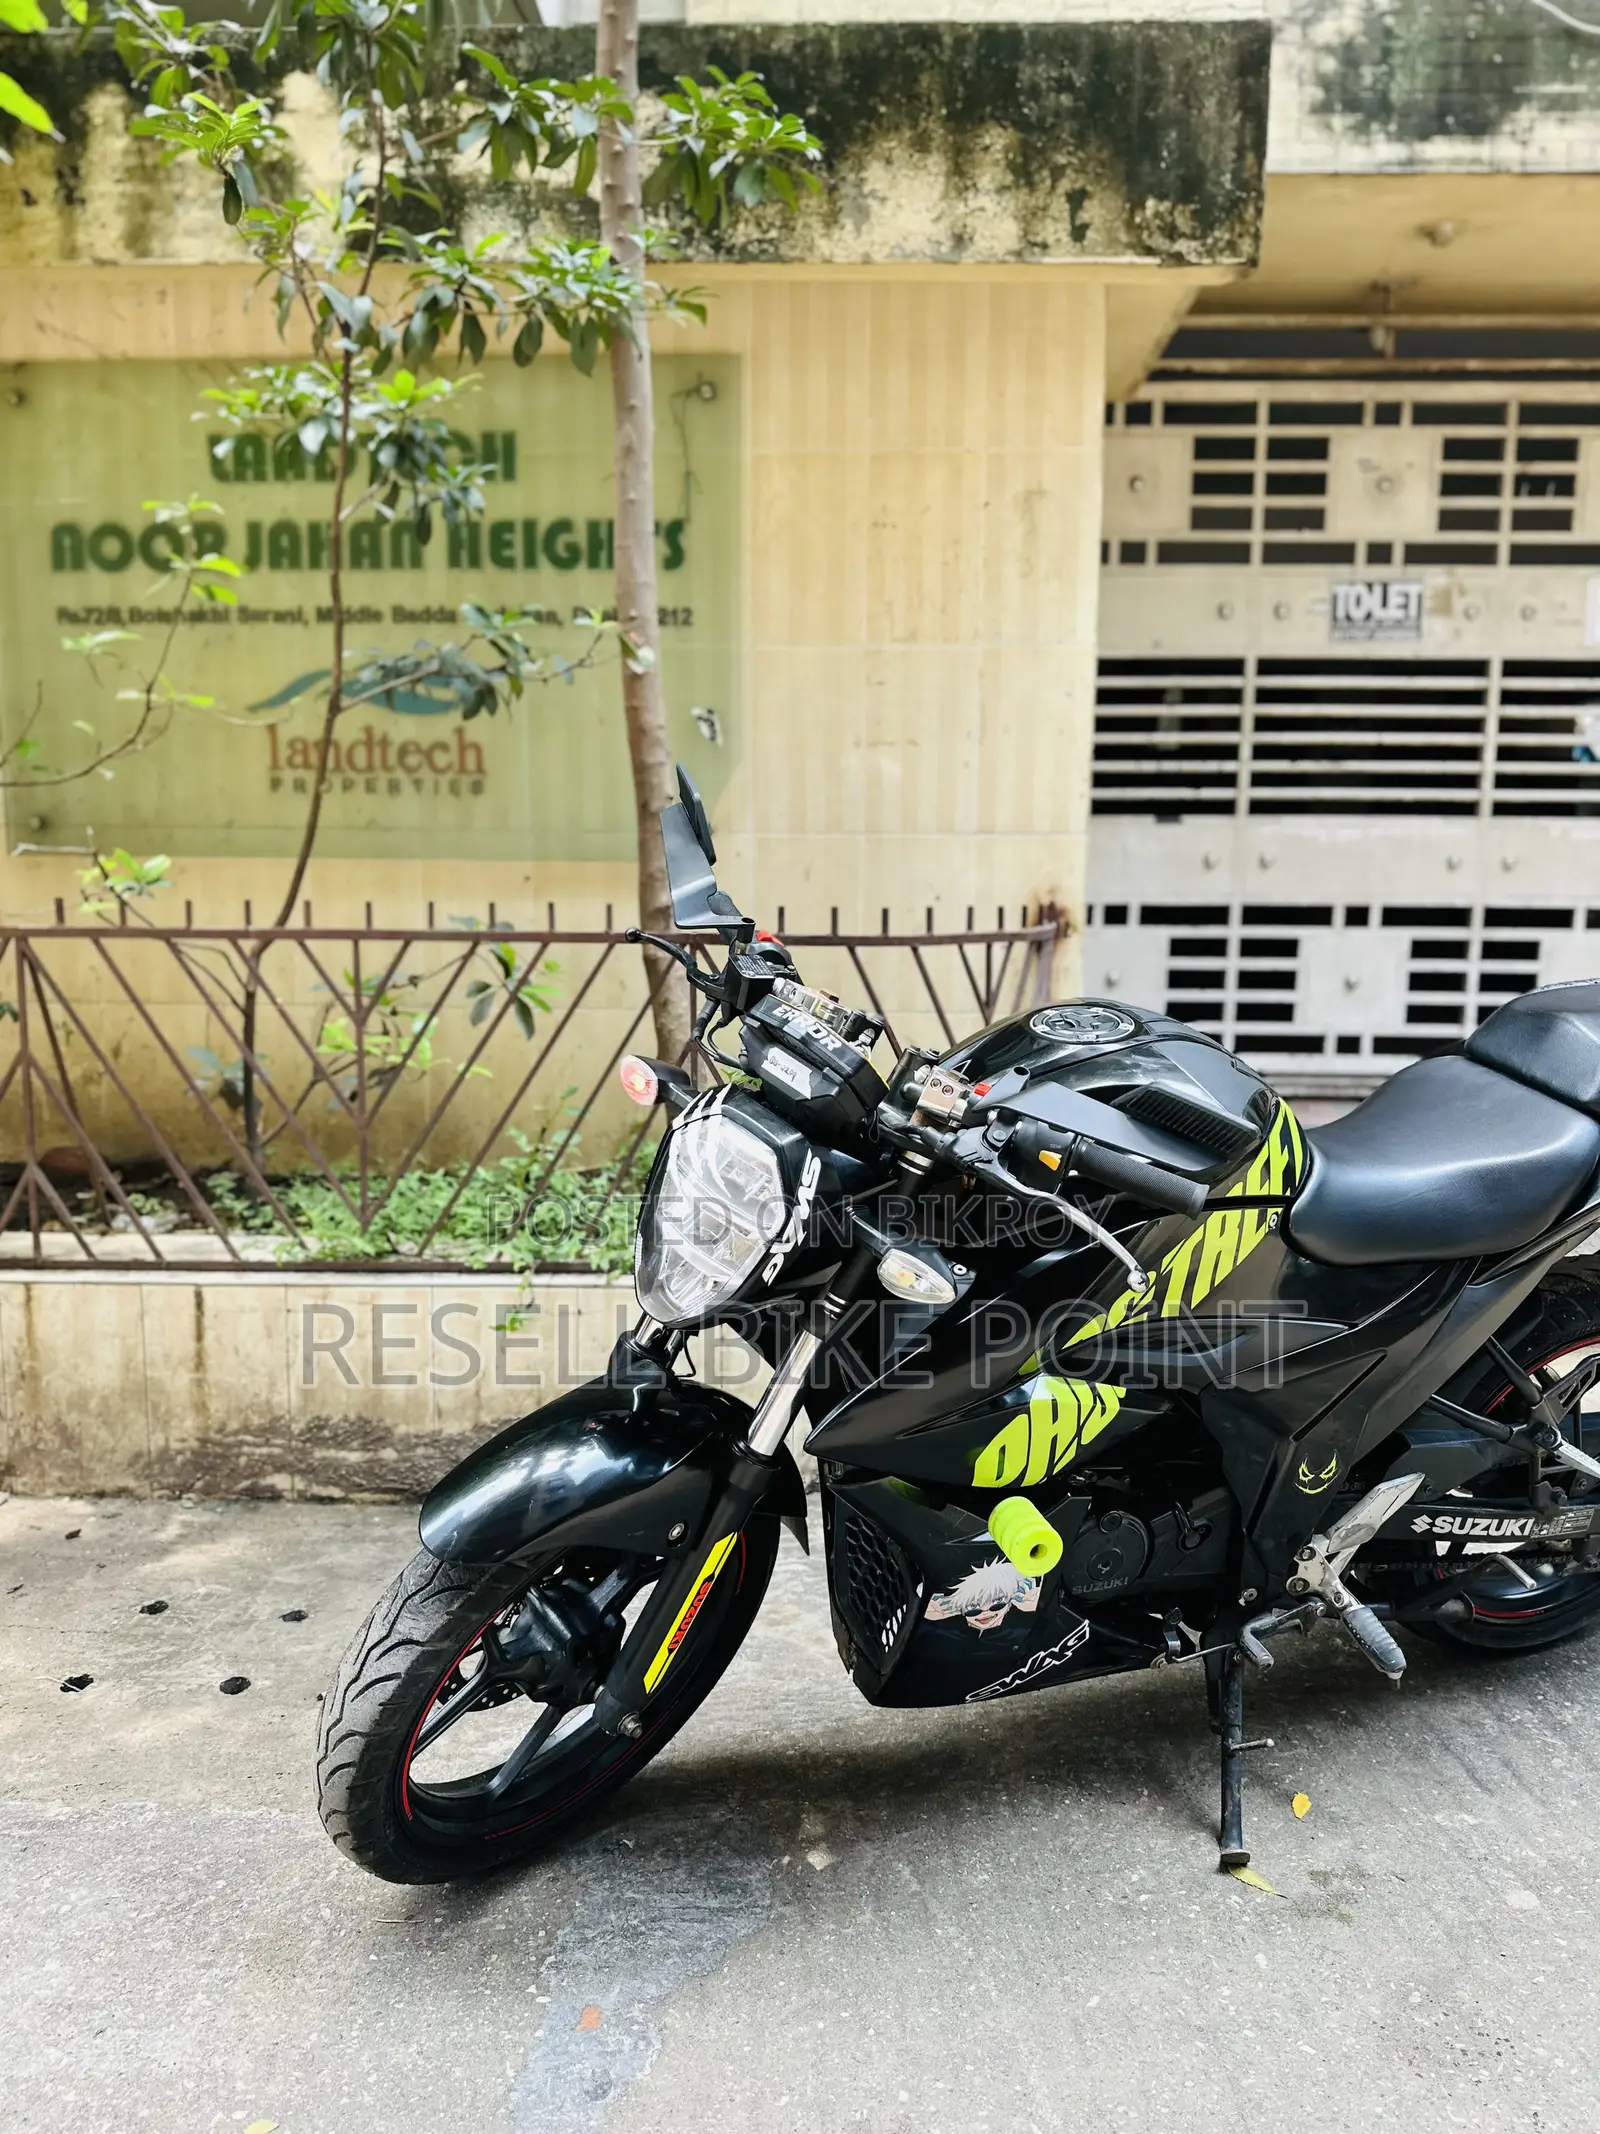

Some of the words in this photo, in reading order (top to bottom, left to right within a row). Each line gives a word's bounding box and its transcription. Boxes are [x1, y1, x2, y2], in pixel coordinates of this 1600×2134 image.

[242, 518, 424, 571] JAHAN
[447, 517, 686, 571] HEIGHS
[265, 723, 486, 775] landtech
[1431, 1515, 1536, 1537] SUZUKI
[1071, 1576, 1130, 1595] SUZUKI
[668, 1580, 714, 1650] SUZUKI
